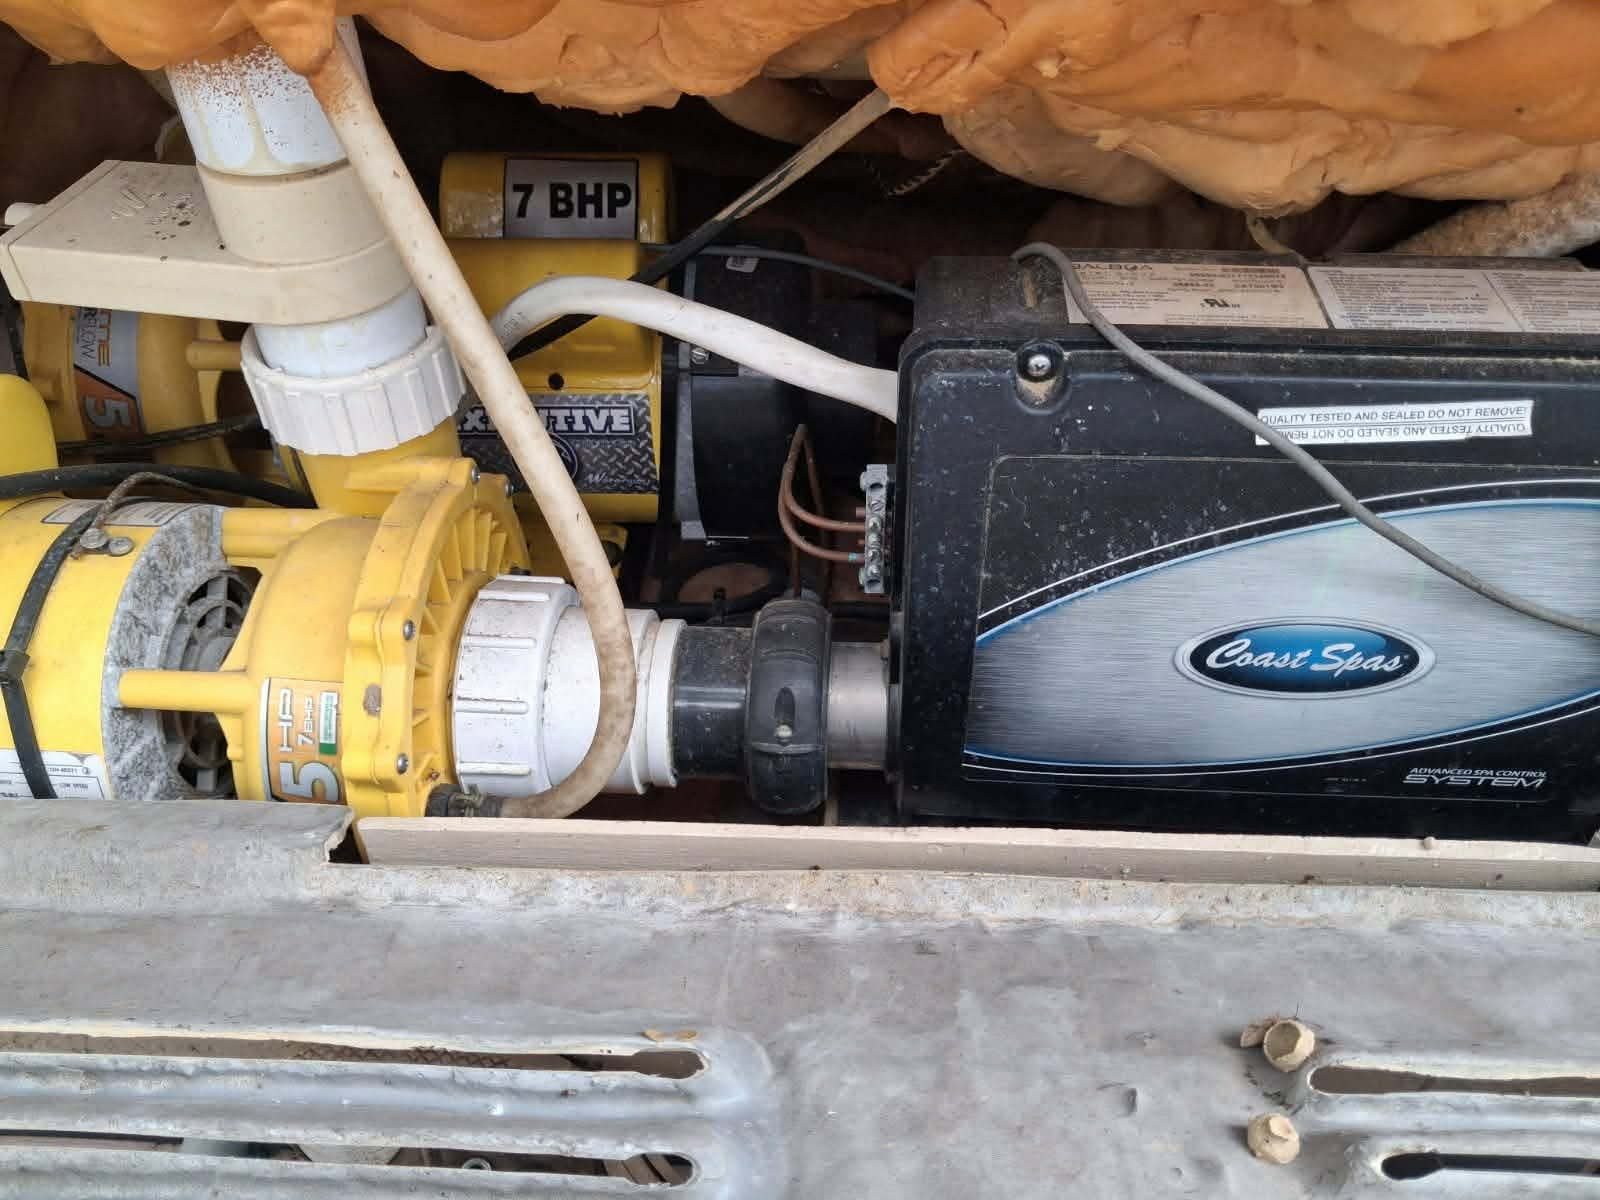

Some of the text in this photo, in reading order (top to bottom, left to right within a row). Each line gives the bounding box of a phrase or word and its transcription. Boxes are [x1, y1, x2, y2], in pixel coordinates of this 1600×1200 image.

[512, 182, 632, 219] 7 BHP
[84, 395, 132, 429] 5
[1261, 414, 1306, 425] QUALITY
[1310, 412, 1351, 423] TESTED
[1354, 411, 1378, 421] AND
[1381, 409, 1426, 421] SEALED
[1428, 409, 1446, 419] DO
[1448, 408, 1473, 418] NOT
[1337, 428, 1354, 438] DO
[1358, 427, 1400, 438] SEALED
[1403, 426, 1427, 436] AND
[1429, 424, 1473, 434] TESTED
[1475, 423, 1526, 433] QUALITY
[1313, 429, 1335, 439] NOT
[1206, 638, 1404, 678] Coast Spas
[278, 688, 338, 800] 5 HP
[1409, 767, 1547, 778] ADVANCED SPA CONTROL
[1402, 774, 1547, 788] SYSTEM
